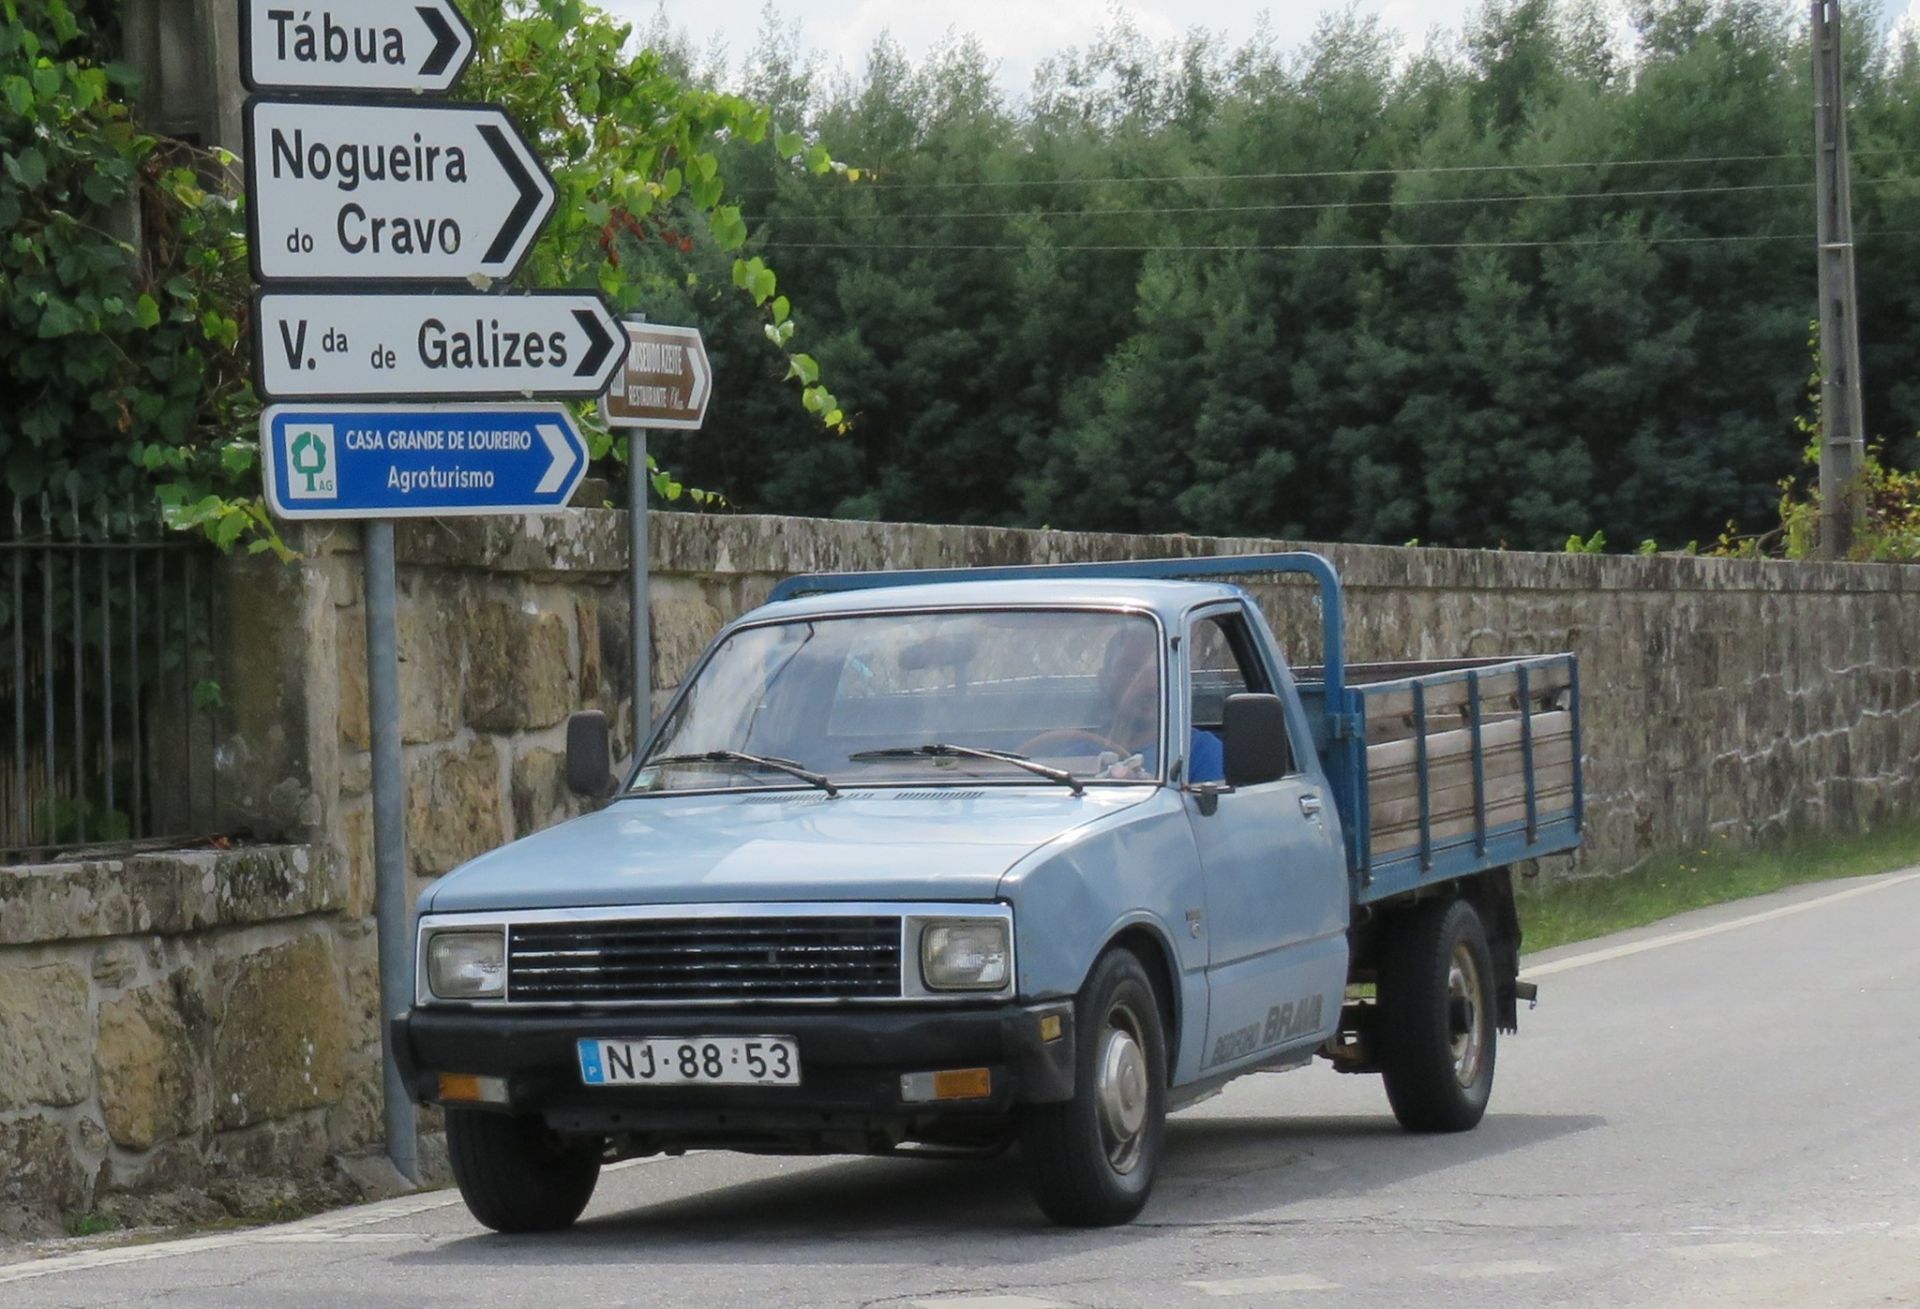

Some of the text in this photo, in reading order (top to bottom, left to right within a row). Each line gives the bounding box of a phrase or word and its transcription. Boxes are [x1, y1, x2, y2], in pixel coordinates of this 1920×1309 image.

[268, 10, 406, 65] Tábua
[271, 128, 467, 191] Nogueira
[287, 203, 461, 255] do Cravo
[371, 344, 397, 369] de
[418, 318, 568, 369] Galizes
[346, 430, 531, 450] CASA GRANDE DE LOUREIRO
[319, 479, 334, 492] AG
[387, 465, 494, 493] Agroturismo
